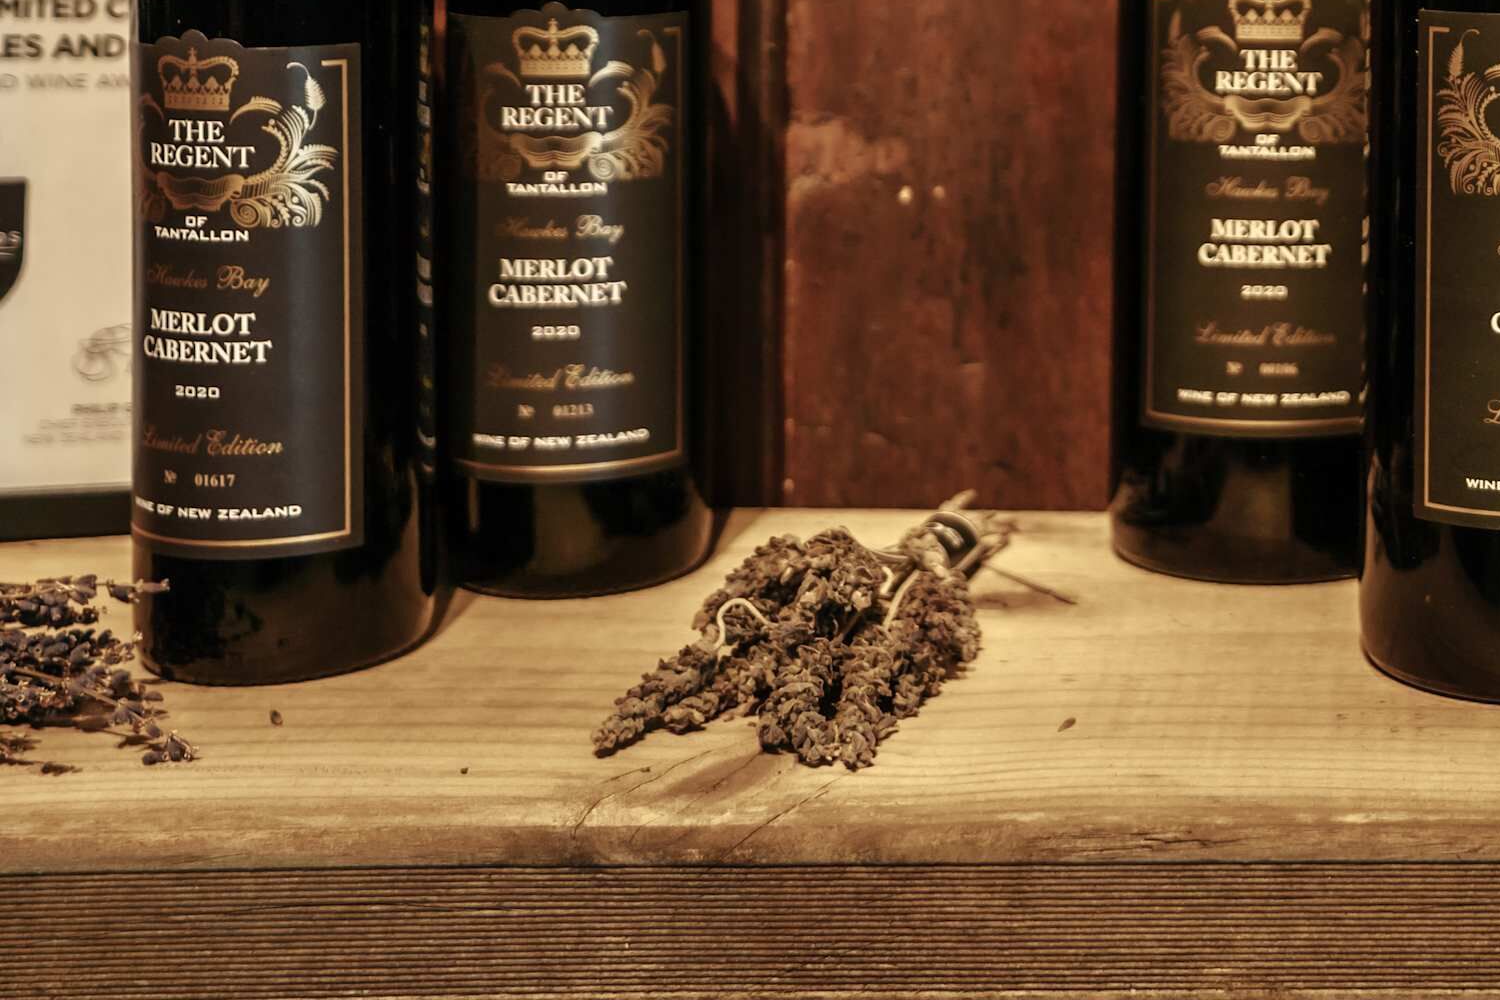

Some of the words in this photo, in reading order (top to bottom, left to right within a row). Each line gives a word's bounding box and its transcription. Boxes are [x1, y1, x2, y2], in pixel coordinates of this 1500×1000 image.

[53, 33, 126, 59] AND
[1239, 49, 1298, 71] THE
[525, 84, 586, 105] THE
[1215, 71, 1324, 95] REGENT
[501, 105, 614, 129] REGENT
[168, 119, 225, 143] THE
[150, 142, 256, 169] REGENT
[506, 181, 608, 196] TANTALLON
[543, 170, 569, 183] OF
[154, 225, 250, 242] TANTALLON
[185, 215, 208, 228] OF
[1210, 218, 1320, 243] MERLOT
[1197, 243, 1332, 269] CABERNET
[216, 264, 270, 297] Bay
[500, 256, 614, 281] MERLOT
[488, 281, 628, 307] CABERNET
[1240, 284, 1288, 300] 2020
[150, 308, 256, 335] MERLOT
[531, 325, 581, 340] 2020
[143, 335, 273, 364] CABERNET
[175, 385, 221, 399] 2020
[206, 429, 283, 457] Edition
[508, 435, 531, 449] OF
[533, 435, 572, 449] NEW
[575, 428, 650, 446] ZEALAND
[194, 473, 236, 488] 01617
[157, 502, 175, 516] OF
[178, 506, 212, 520] NEW
[217, 505, 303, 521] ZEALAND
